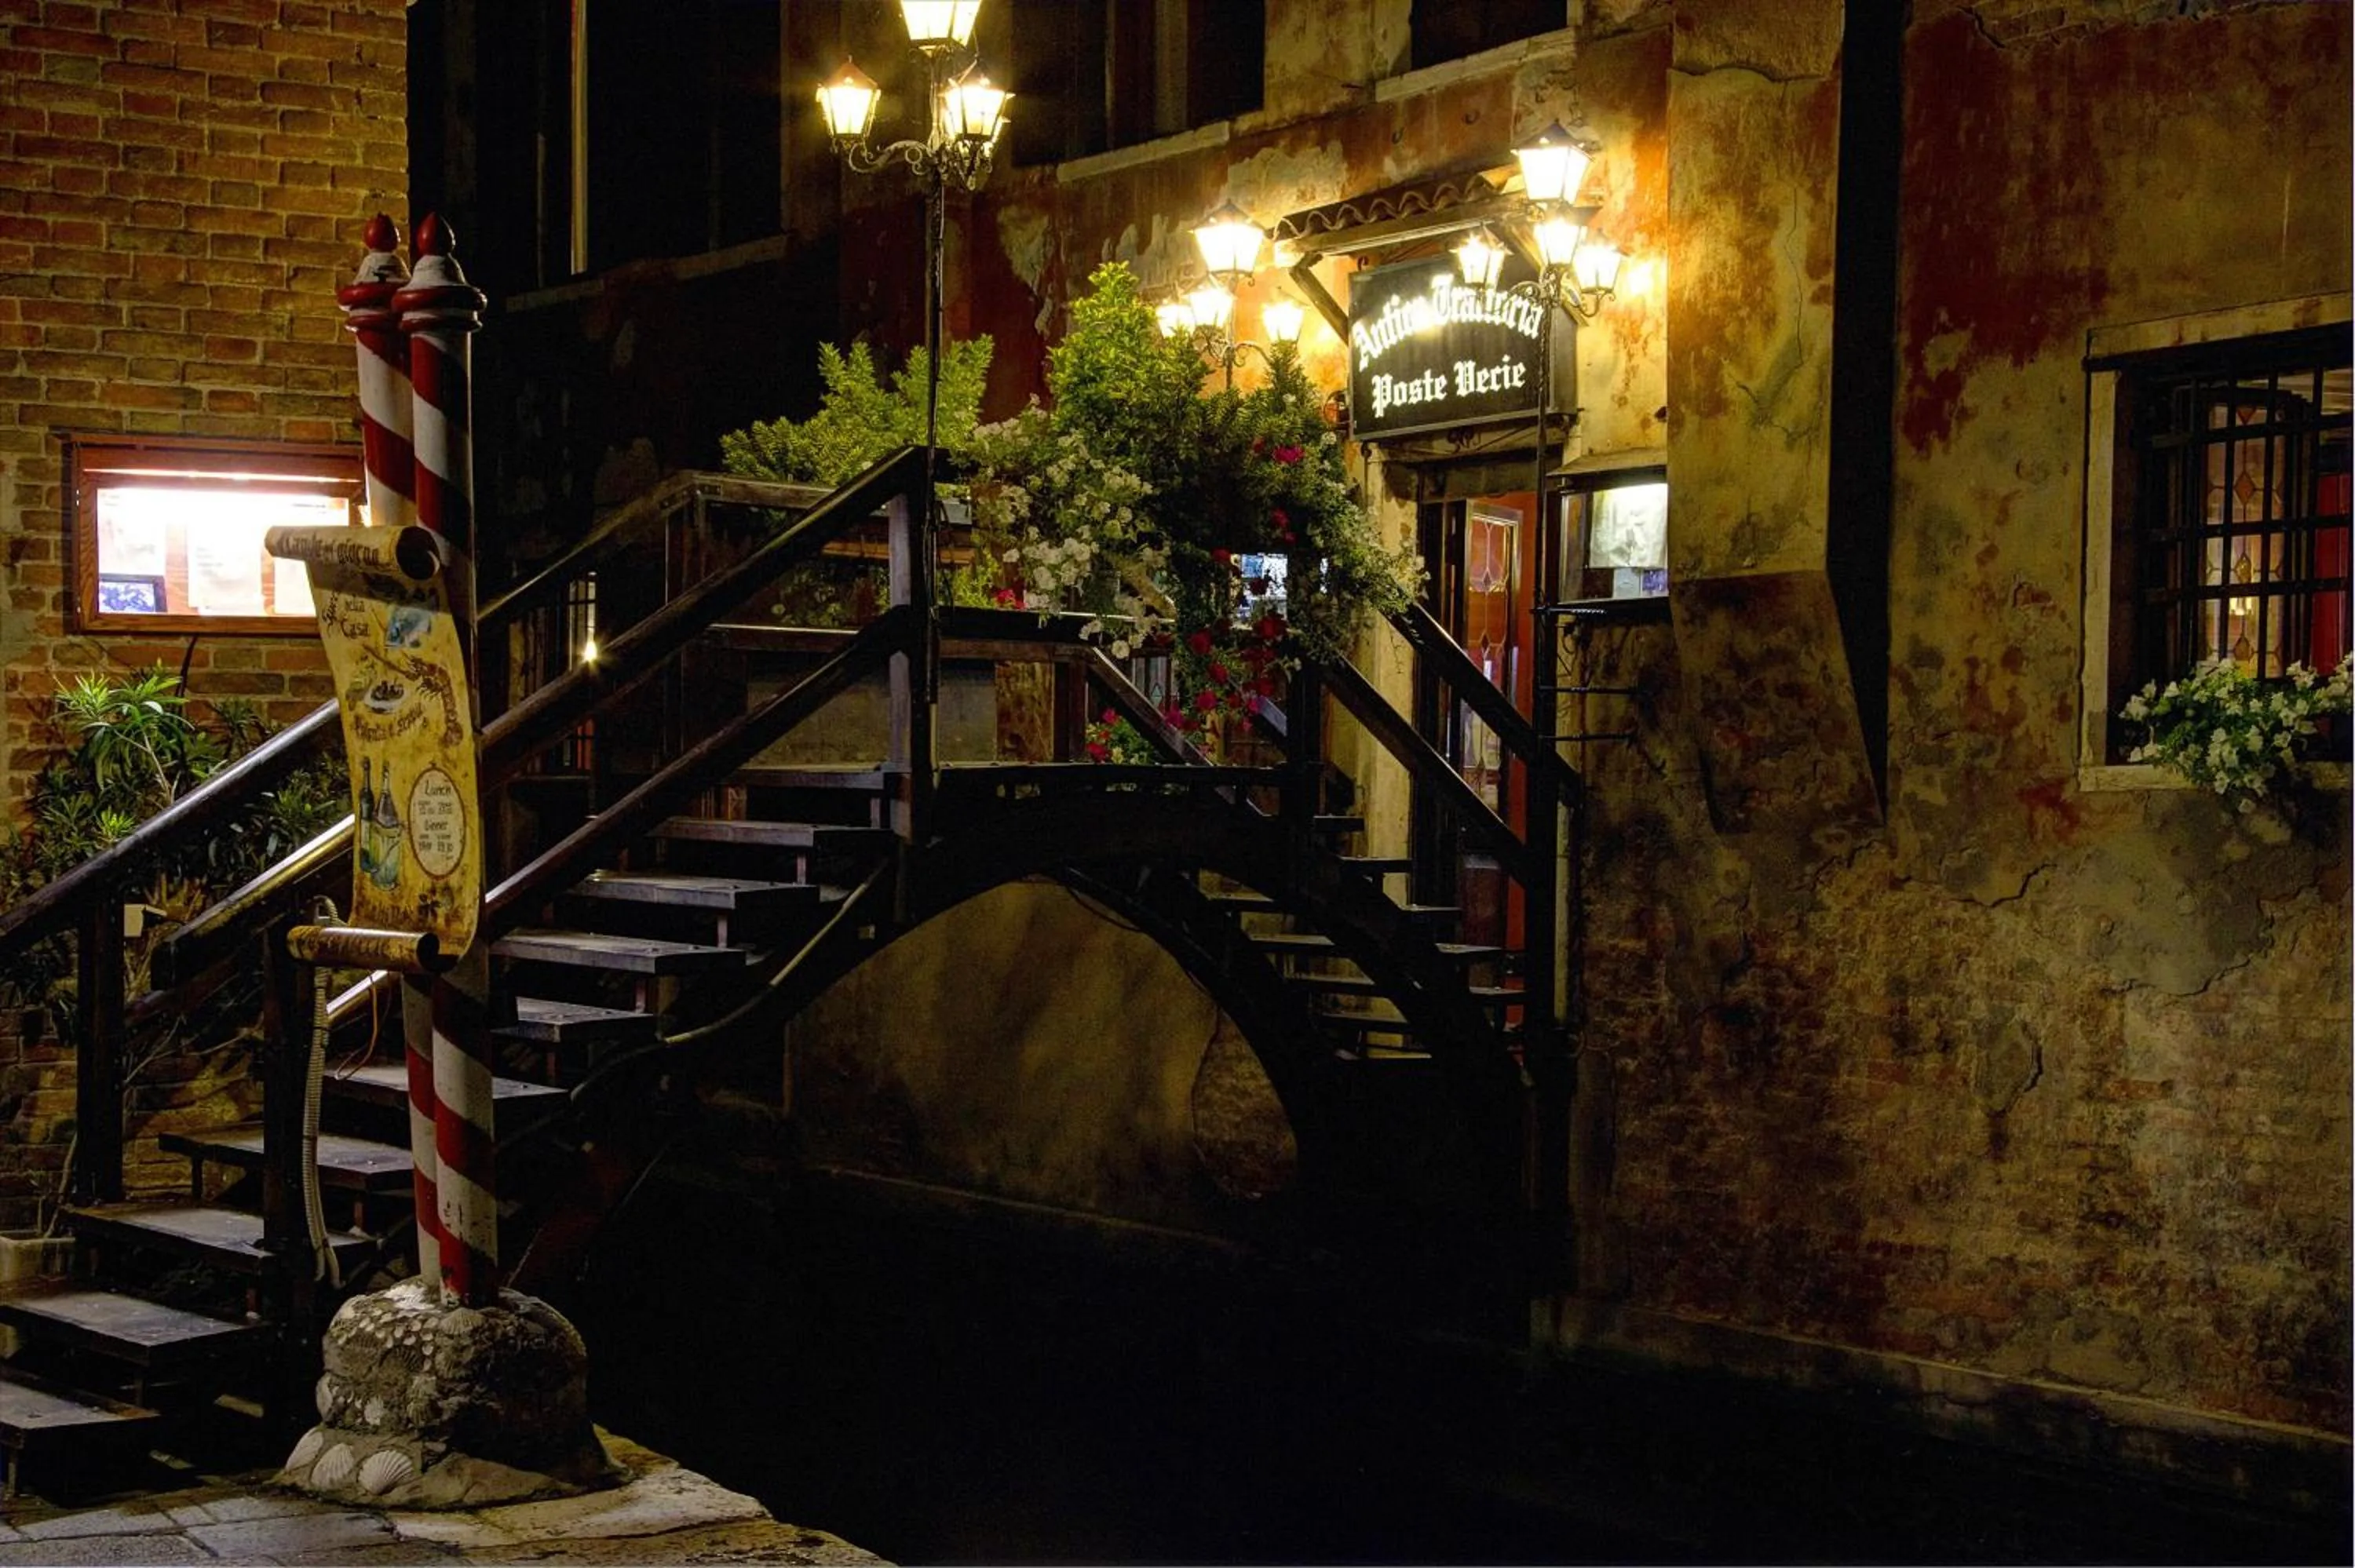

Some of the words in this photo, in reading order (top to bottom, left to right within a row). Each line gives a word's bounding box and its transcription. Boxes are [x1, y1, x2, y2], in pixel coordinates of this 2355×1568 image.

[1371, 369, 1448, 418] Poste
[340, 618, 370, 639] Casa
[425, 779, 451, 797] Lunch
